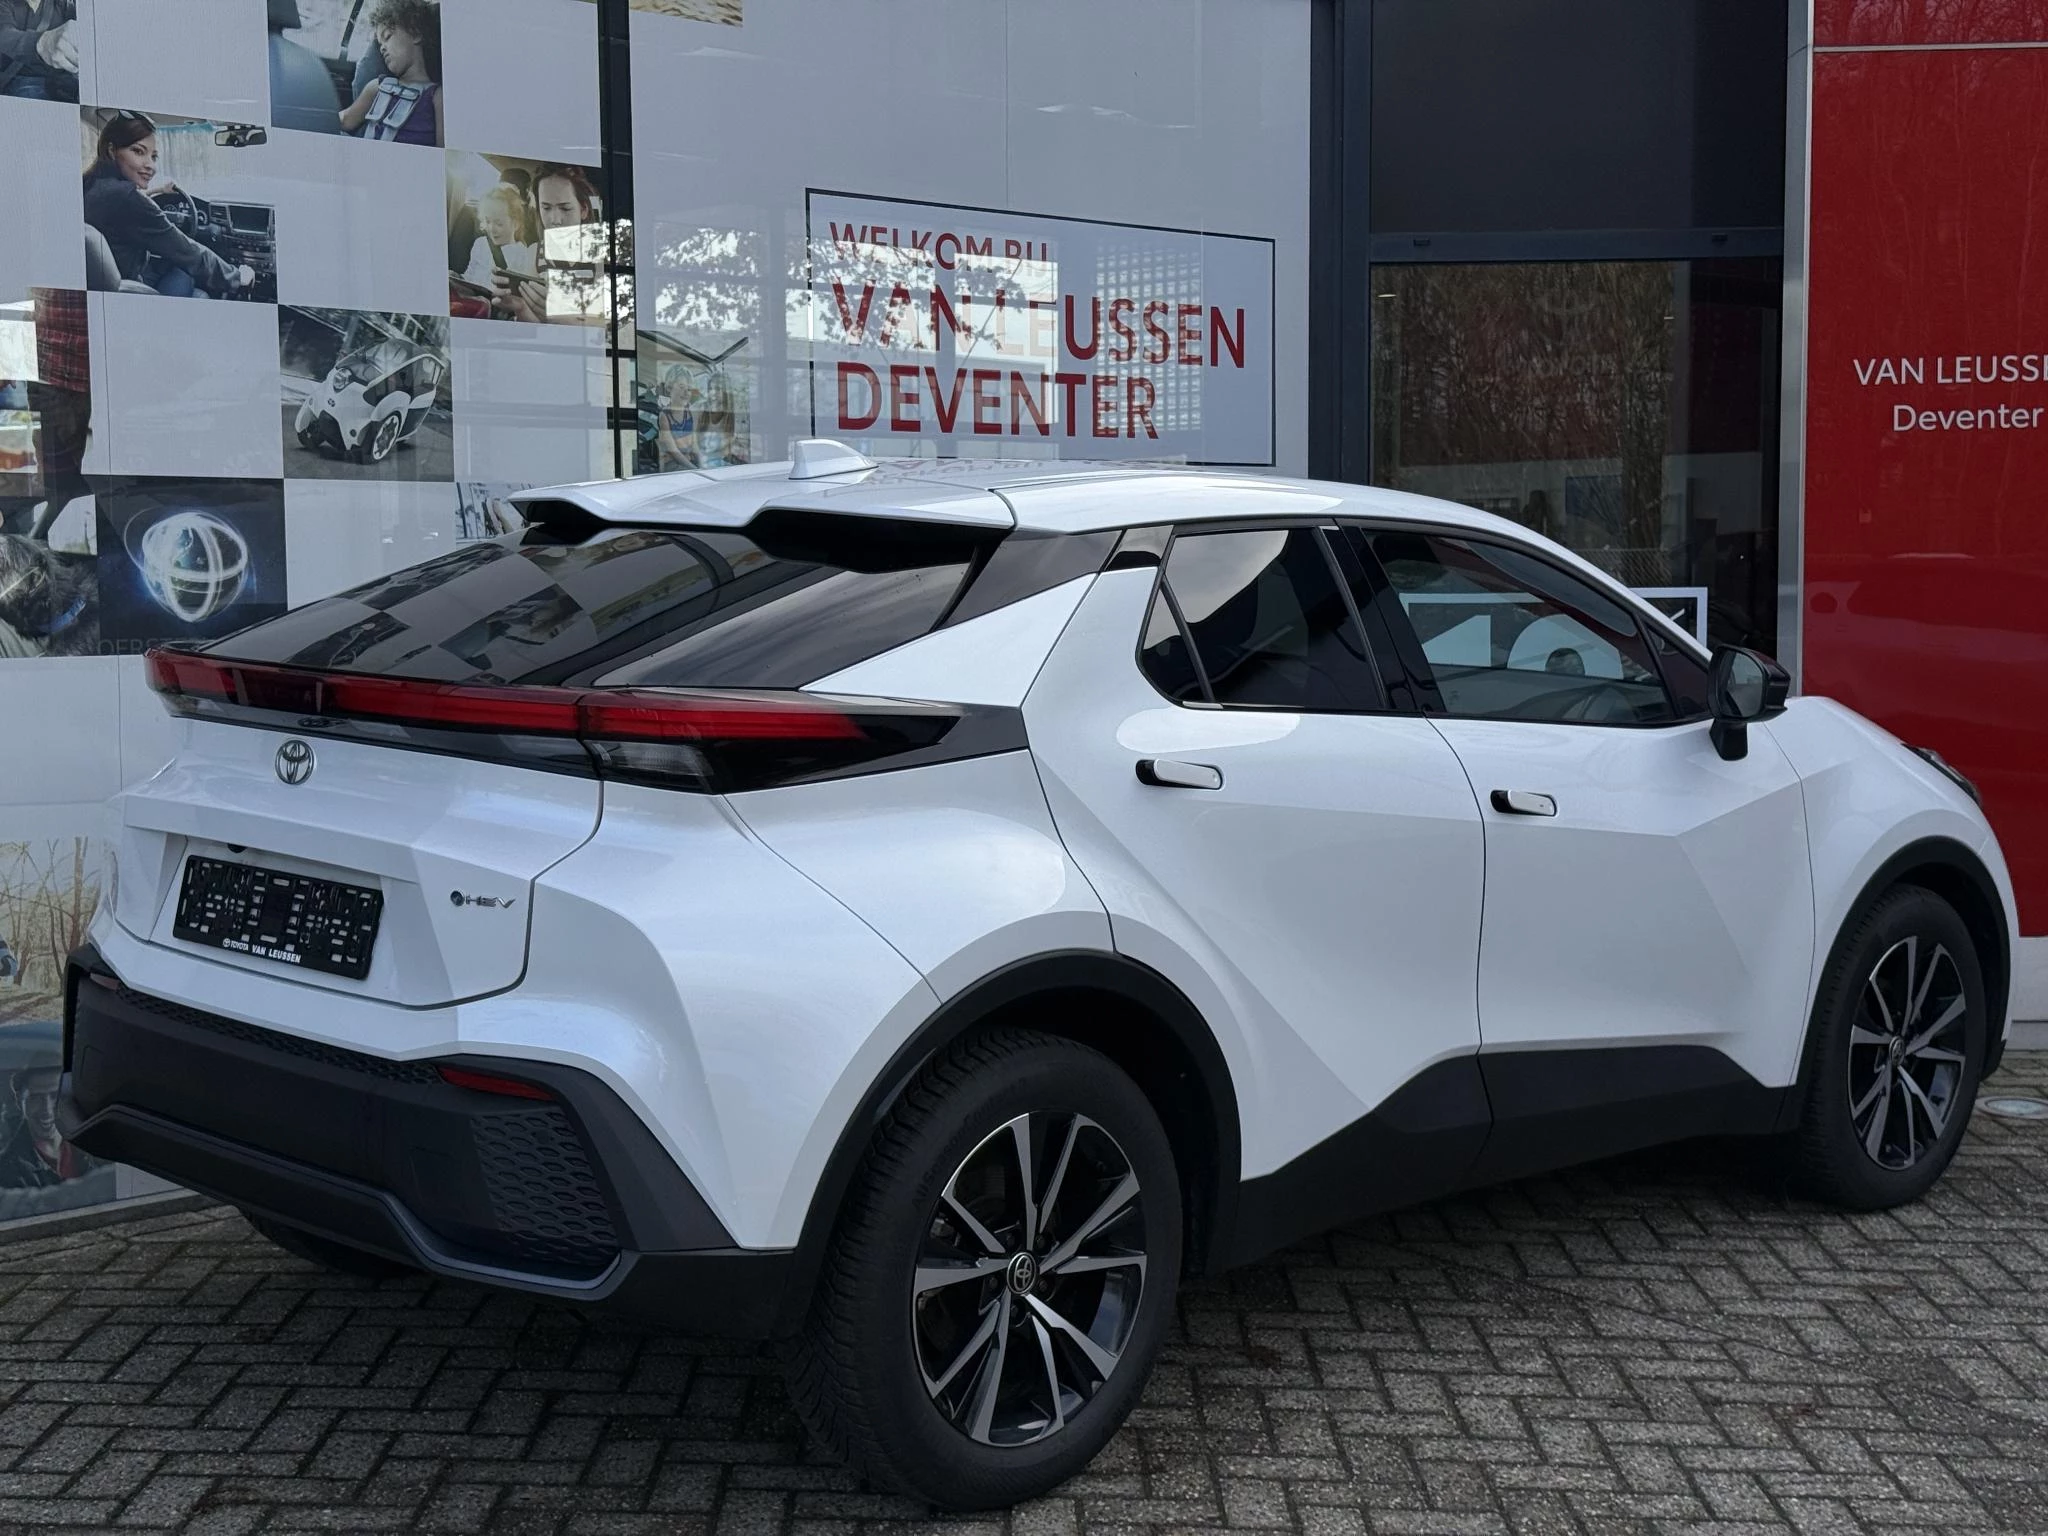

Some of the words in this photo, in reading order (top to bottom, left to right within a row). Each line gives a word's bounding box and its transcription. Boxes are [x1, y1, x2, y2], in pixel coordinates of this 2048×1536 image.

[831, 275, 973, 353] VAN
[1853, 357, 1924, 385] VAN
[837, 361, 1160, 440] DEVENTER
[1893, 403, 2044, 431] Deventer
[251, 944, 267, 956] VAN
[268, 948, 302, 963] LEUSSEN
